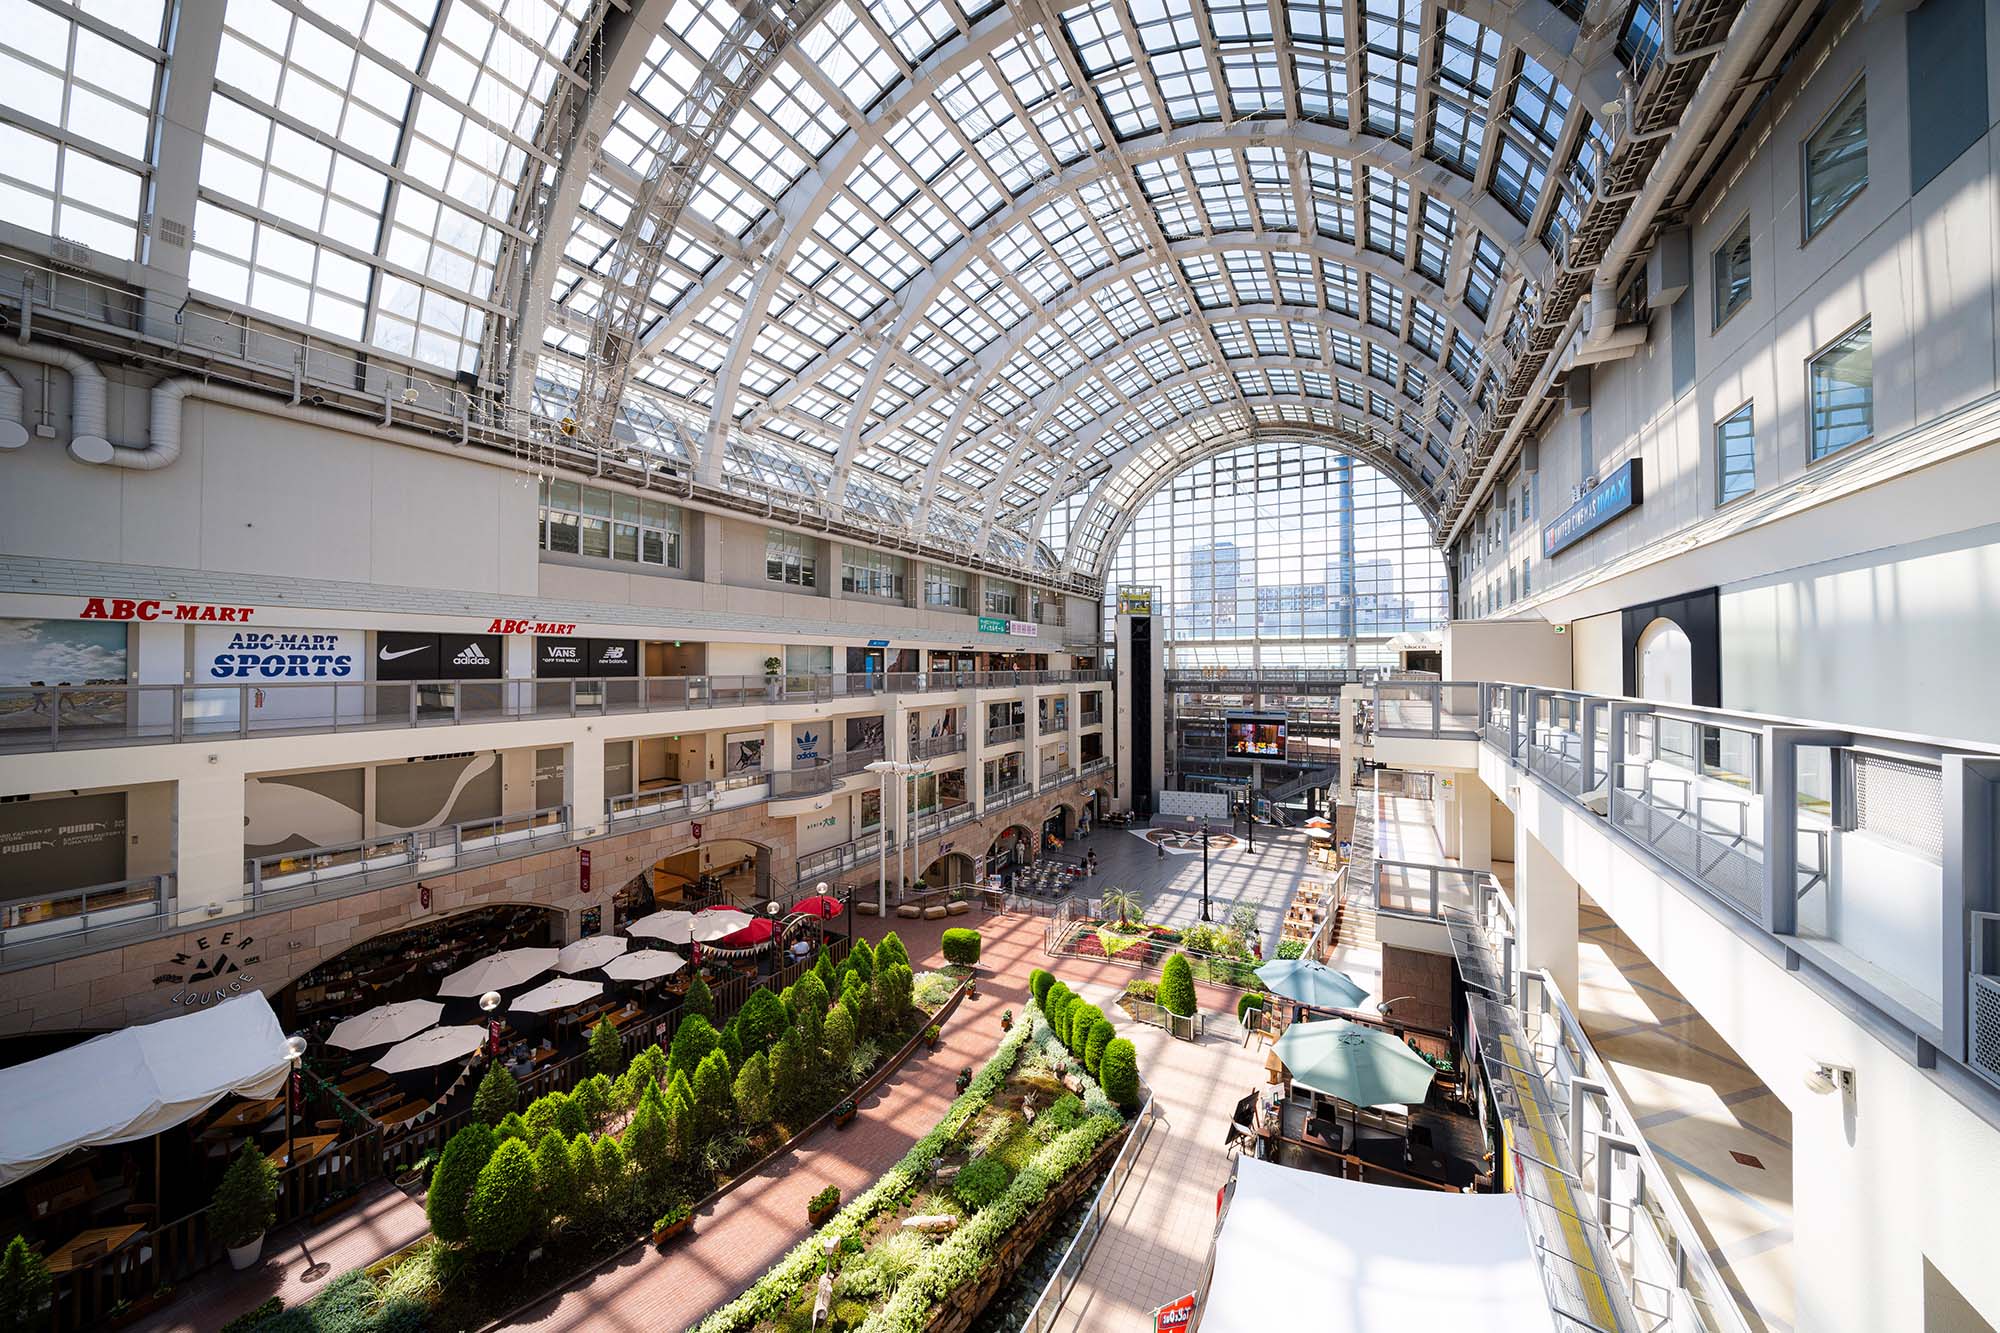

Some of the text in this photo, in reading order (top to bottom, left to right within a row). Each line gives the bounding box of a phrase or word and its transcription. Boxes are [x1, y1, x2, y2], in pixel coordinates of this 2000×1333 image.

[1572, 499, 1597, 531] CINEMAS
[1598, 476, 1628, 515] IMAX
[80, 598, 254, 622] ABC-MART
[488, 619, 576, 635] ABC-MART
[228, 632, 338, 650] ABC-MART
[548, 646, 576, 657] VANS
[211, 654, 352, 678] SPORTS
[453, 656, 490, 665] adidas
[171, 973, 254, 1005] LOUNGE
